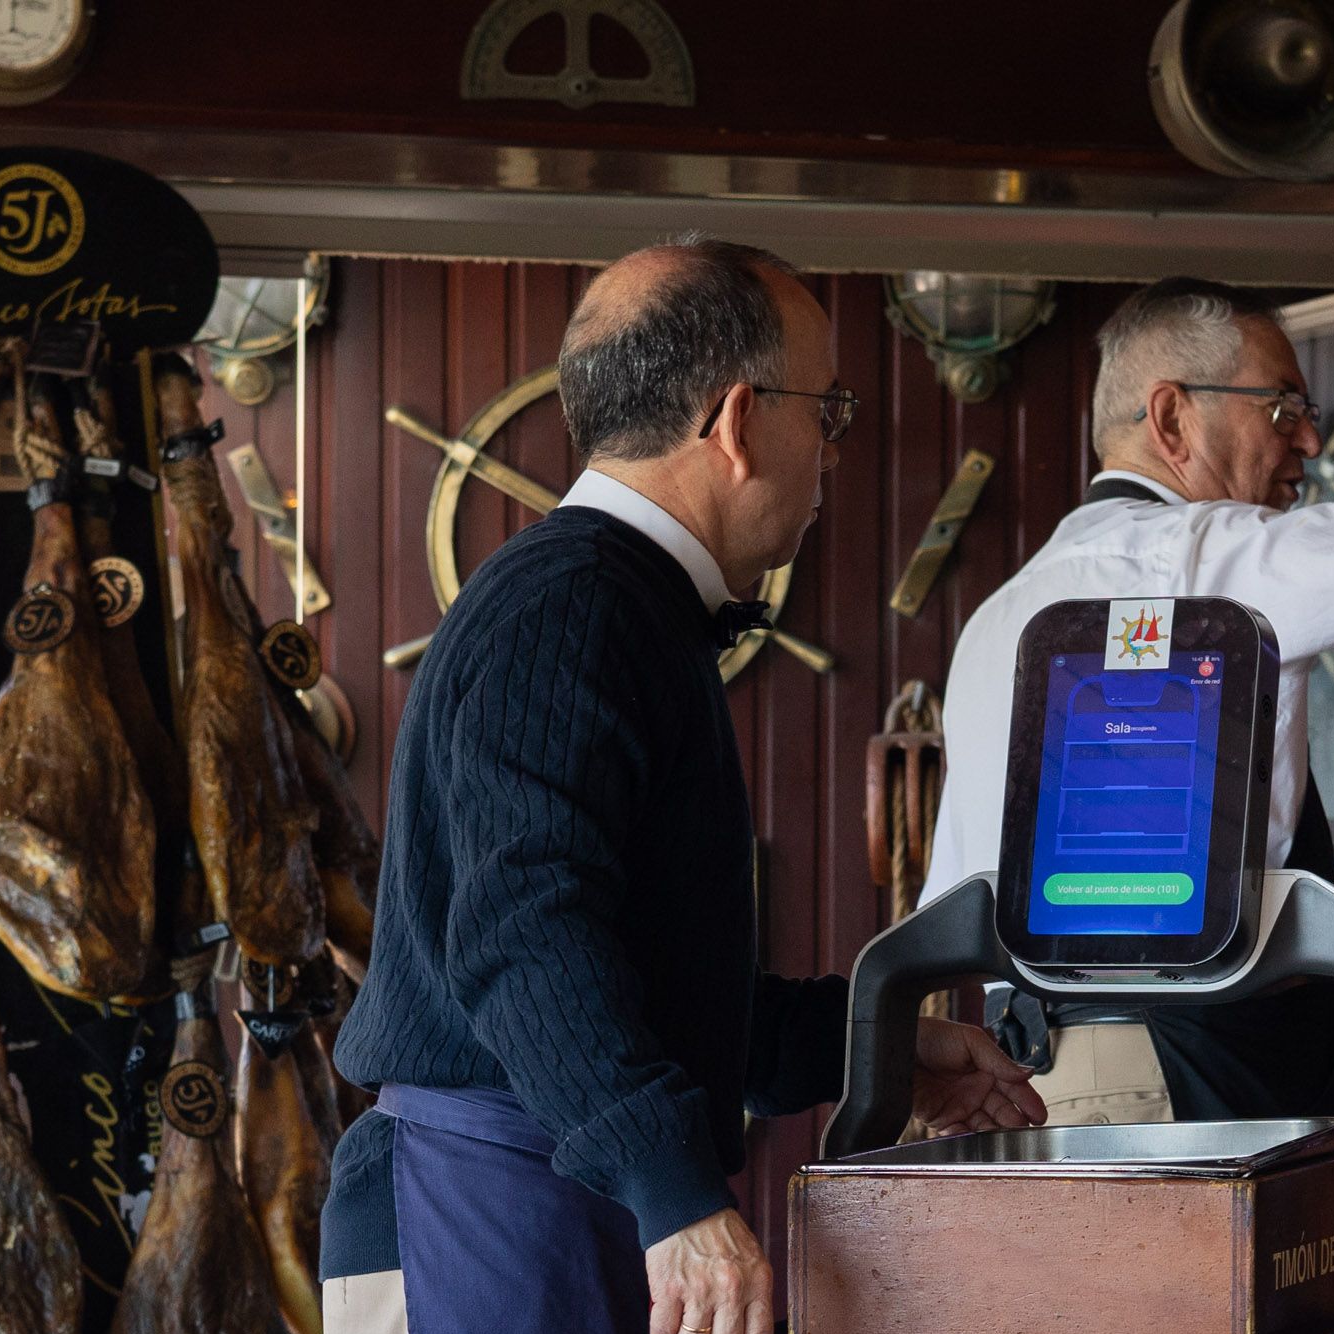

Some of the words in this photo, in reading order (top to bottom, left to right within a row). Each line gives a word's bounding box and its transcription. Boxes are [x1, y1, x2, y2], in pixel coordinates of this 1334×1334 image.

[1105, 722, 1131, 734] Sala
[1057, 884, 1083, 894] Volver
[1085, 884, 1093, 894] al
[1094, 885, 1119, 896] punto
[1120, 884, 1132, 894] de
[1133, 884, 1156, 894] inicio
[1157, 884, 1180, 895] (101)
[1273, 1230, 1317, 1291] TIMÓN
